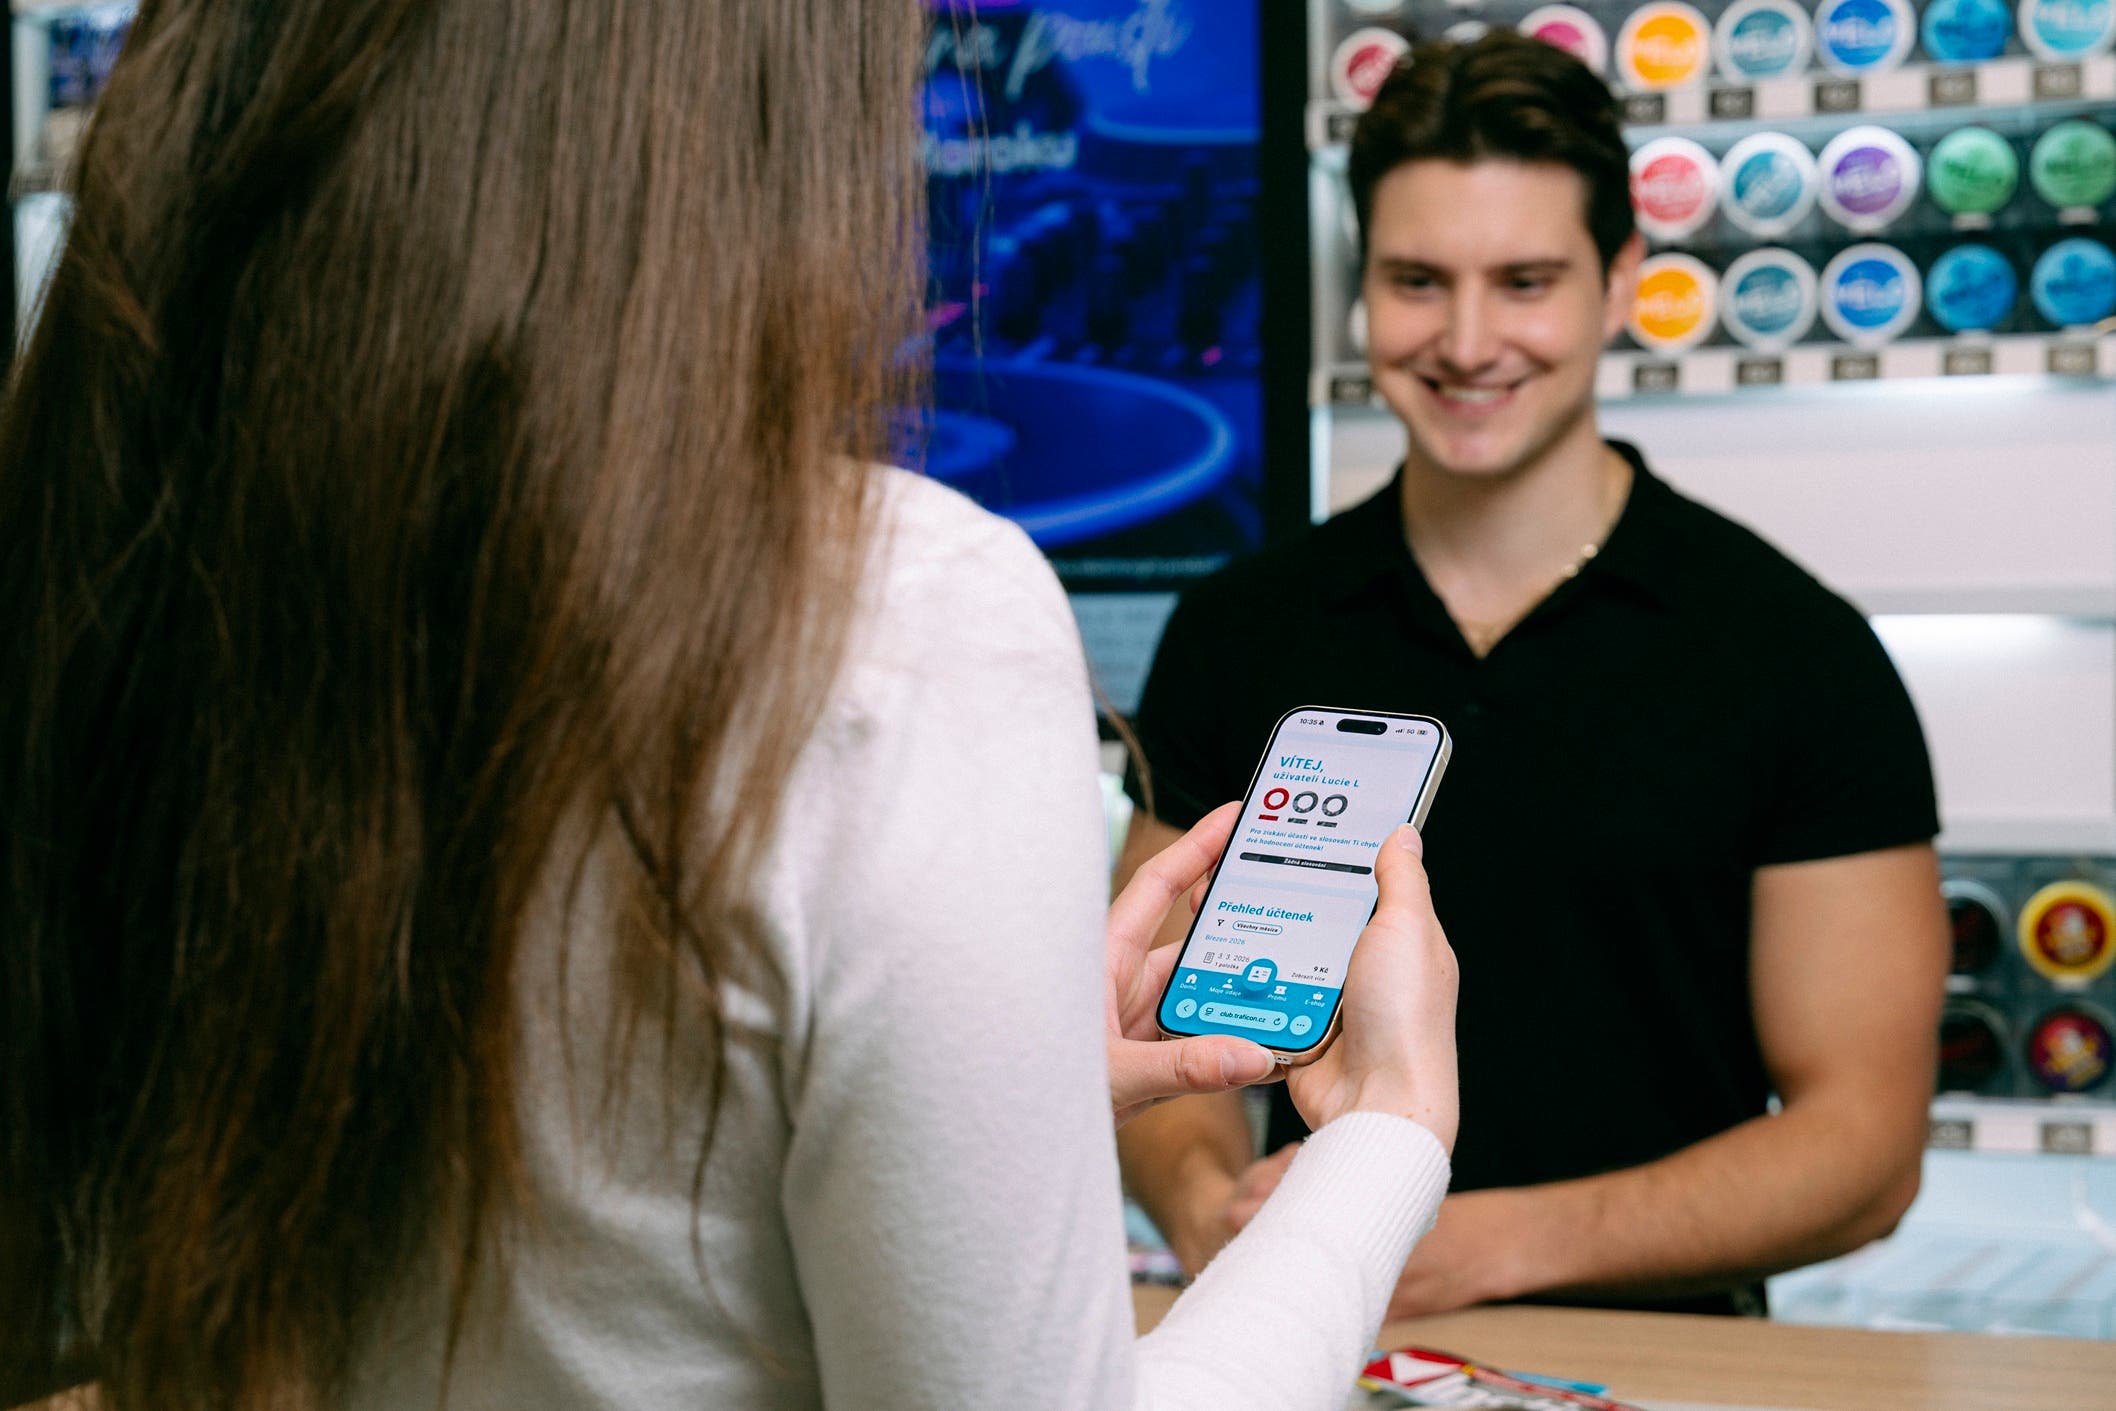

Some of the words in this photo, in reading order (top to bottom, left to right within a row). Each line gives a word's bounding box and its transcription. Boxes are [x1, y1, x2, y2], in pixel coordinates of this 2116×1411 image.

[1280, 756, 1324, 772] VÍTEJ,
[1273, 772, 1319, 783] uživateli
[1321, 776, 1351, 787] Lucie
[1259, 838, 1294, 848] hodnocení
[1294, 842, 1324, 851] účtenek!
[1319, 835, 1351, 845] slosování
[1218, 901, 1264, 916] Přehled
[1266, 908, 1314, 922] účtenek
[1237, 923, 1259, 931] Všechny
[1205, 934, 1228, 943] Březen
[1228, 937, 1246, 945] 2026
[1319, 966, 1329, 974] Kč
[1208, 986, 1224, 995] Moje
[1267, 993, 1288, 1002] Promo
[1304, 999, 1326, 1008] E-shop
[1220, 1010, 1267, 1023] club.traficon.cz
